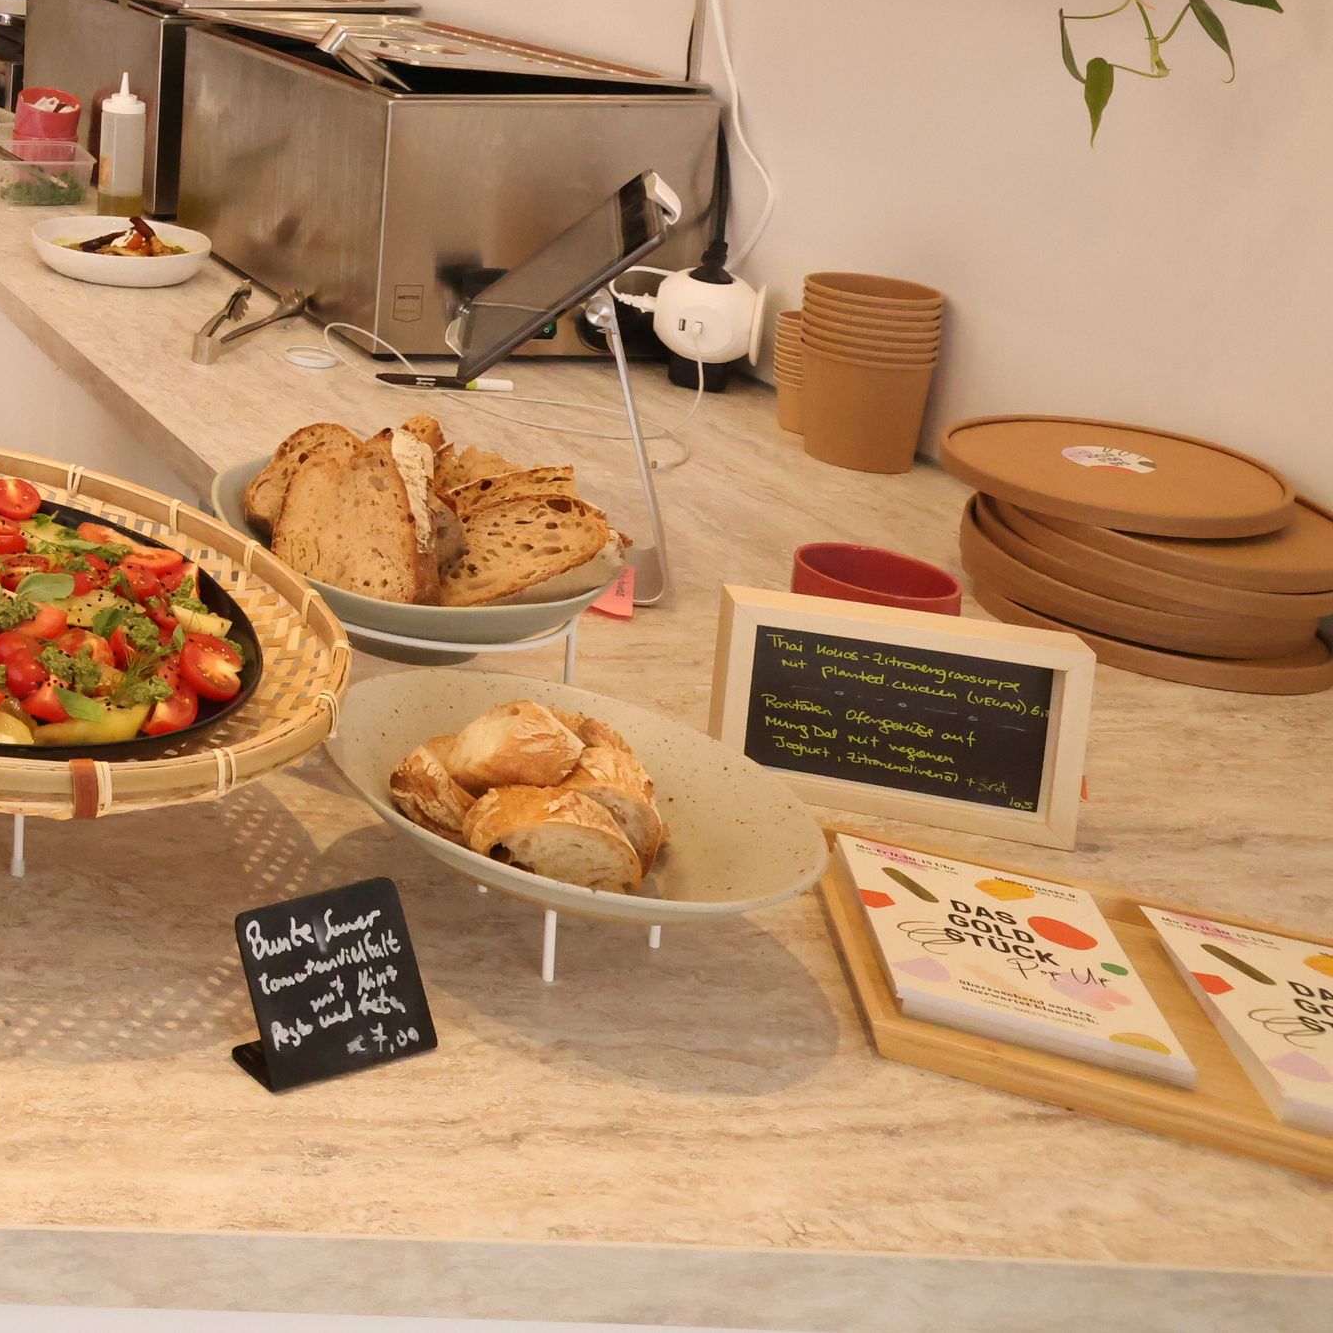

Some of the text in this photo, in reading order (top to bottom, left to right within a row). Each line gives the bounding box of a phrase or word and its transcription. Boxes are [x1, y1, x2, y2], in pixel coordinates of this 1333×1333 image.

[766, 634, 803, 652] Thai
[847, 735, 879, 747] mit
[941, 731, 976, 747] auf
[950, 899, 1017, 925] DAS
[245, 917, 315, 960] Bunte
[948, 914, 1035, 944] GOLD
[944, 928, 1060, 966] STÜCK
[1007, 957, 1111, 988] Pop Up
[1287, 980, 1333, 1001] DA
